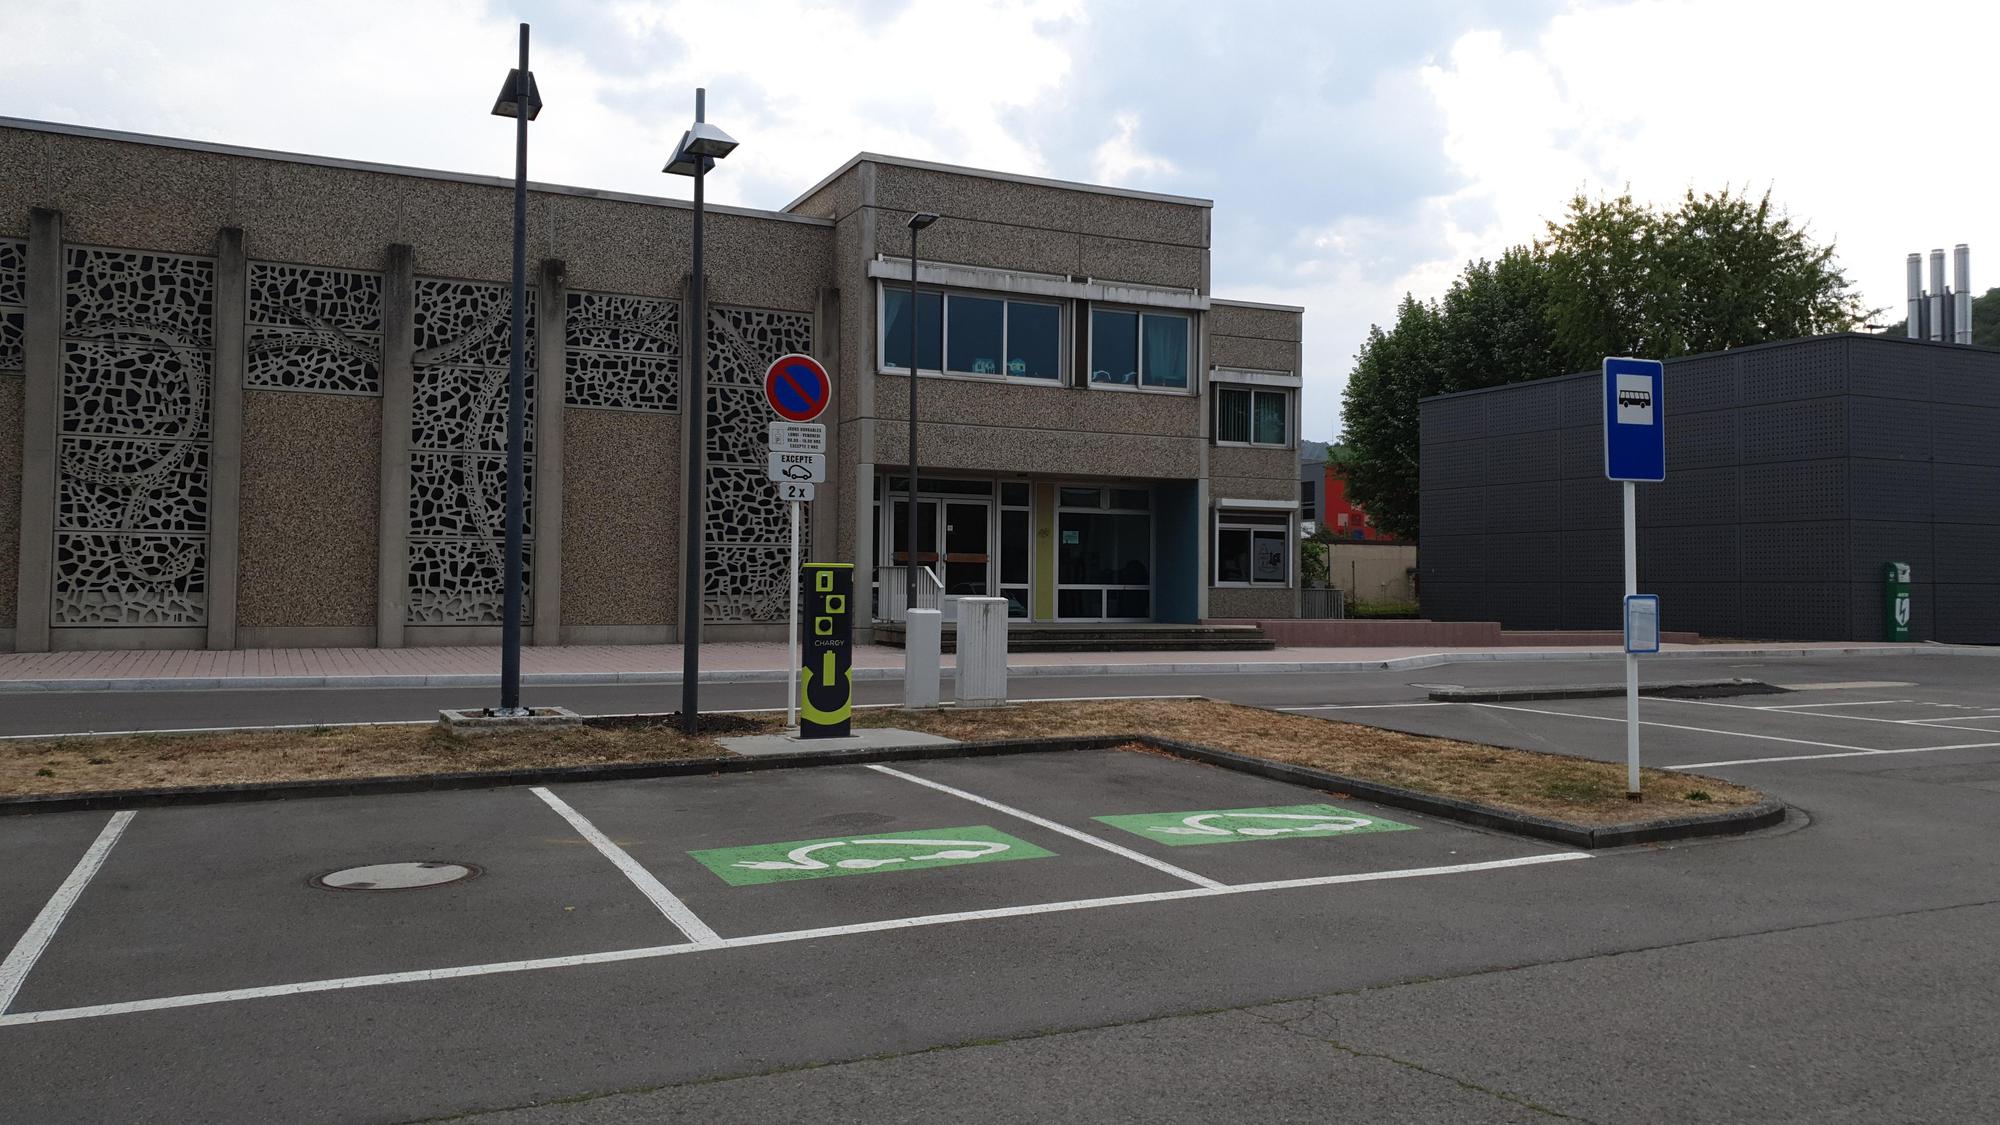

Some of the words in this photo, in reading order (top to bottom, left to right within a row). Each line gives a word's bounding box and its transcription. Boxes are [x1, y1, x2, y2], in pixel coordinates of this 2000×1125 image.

[781, 455, 813, 464] EXCEPTE
[788, 485, 796, 498] 2
[814, 639, 845, 647] CHARGY
